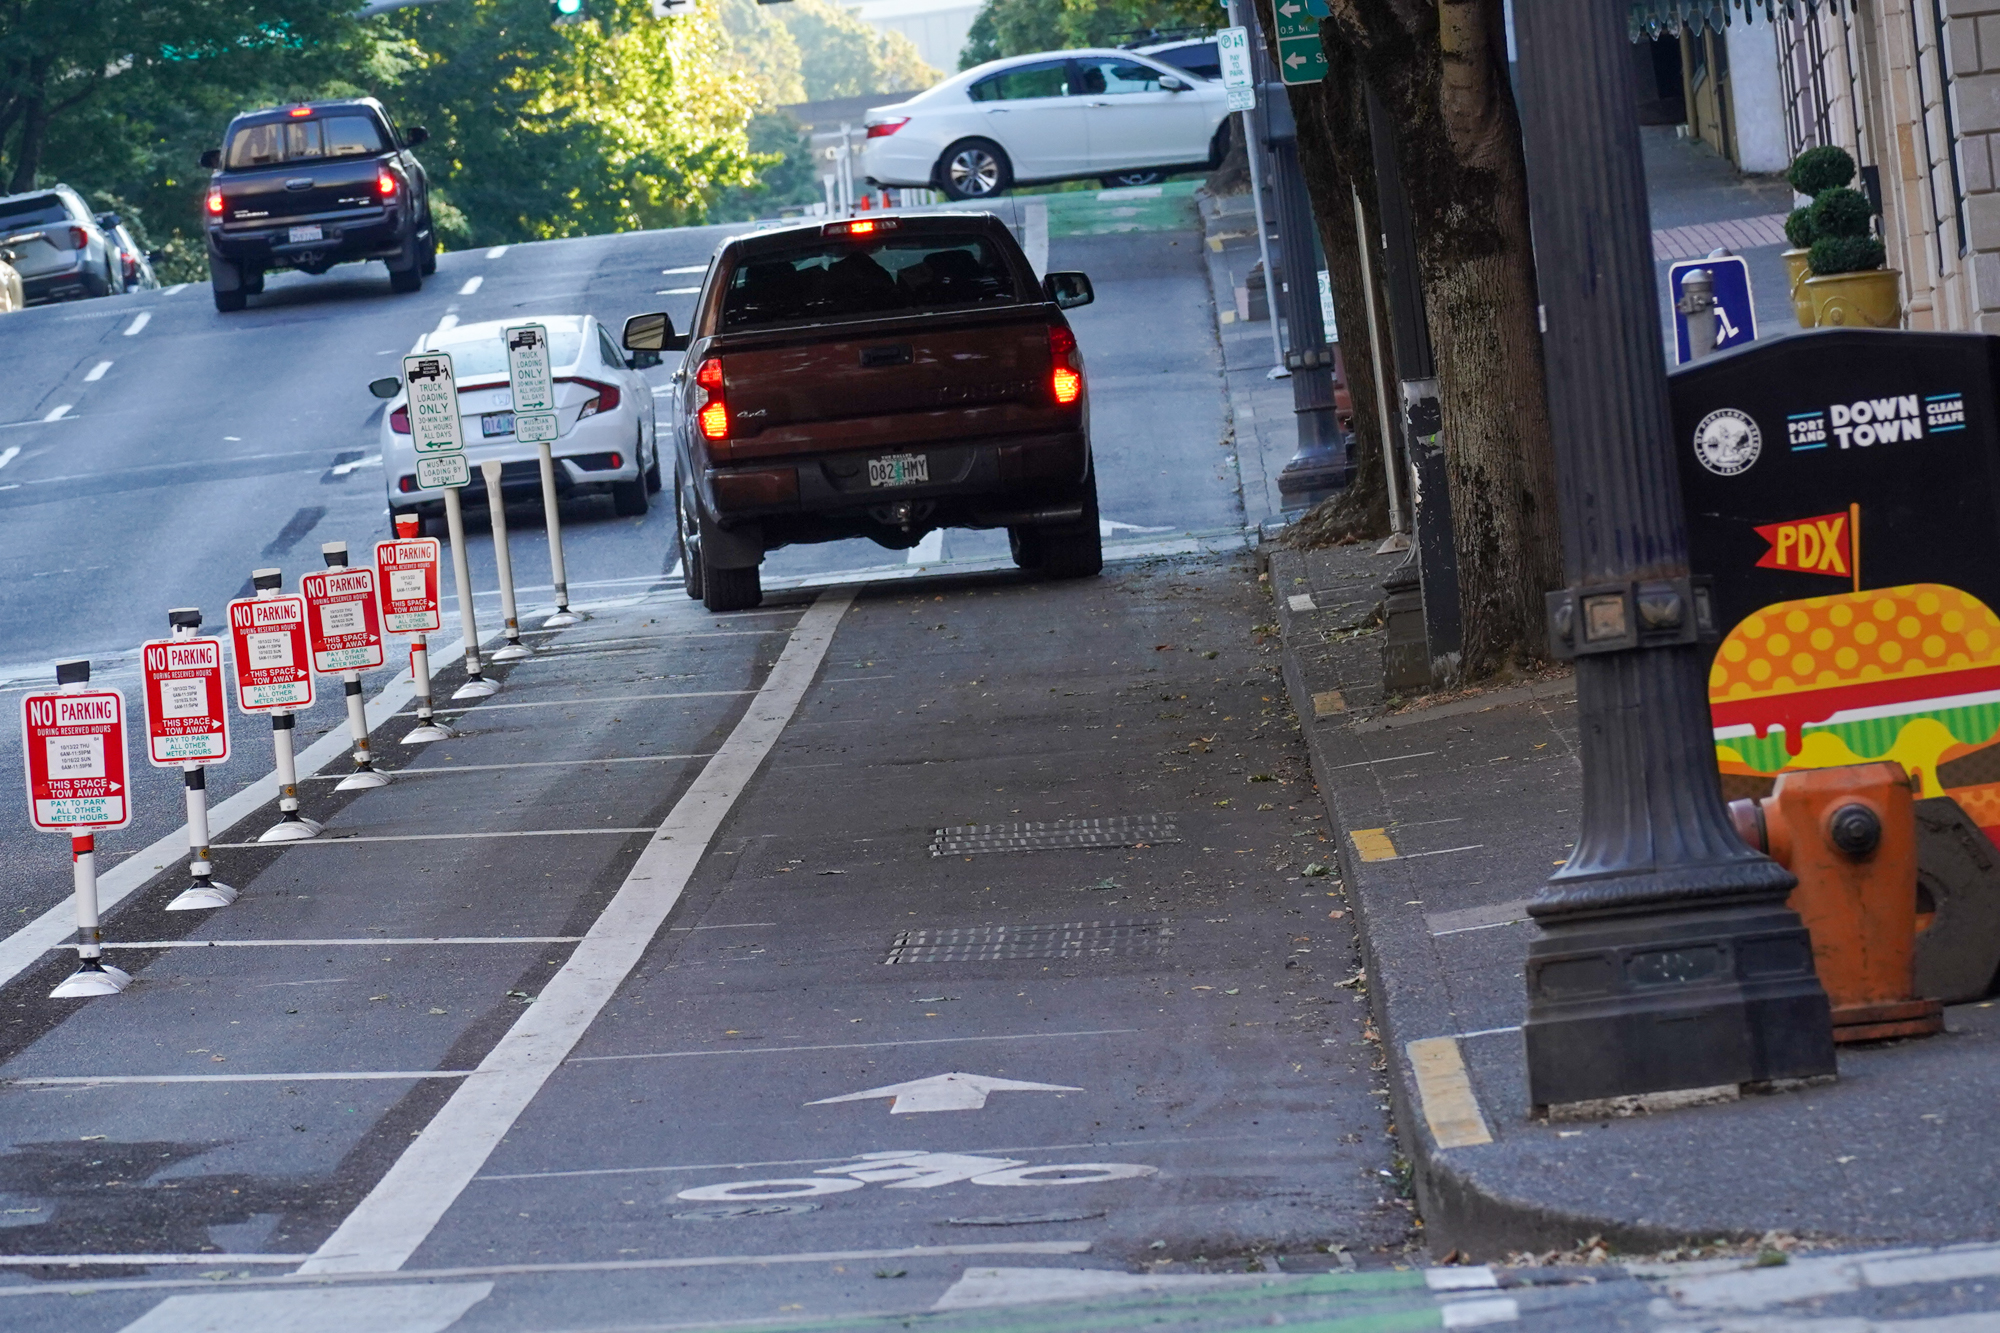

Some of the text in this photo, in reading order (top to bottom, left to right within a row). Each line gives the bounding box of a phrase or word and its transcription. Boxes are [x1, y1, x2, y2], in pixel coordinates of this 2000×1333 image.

[1280, 26, 1294, 34] 0.5
[517, 360, 542, 368] LOADING
[518, 369, 542, 379] ONLY
[419, 383, 442, 392] TRUCK
[417, 393, 448, 402] LOADING
[419, 403, 448, 415] ONLY
[1830, 395, 1920, 427] DOWN
[1926, 401, 1963, 414] CLEAN
[418, 416, 438, 424] 30-MIN
[1927, 411, 1965, 426] &SAFE
[1788, 419, 1825, 433] PORT
[1789, 430, 1826, 444] LAND
[1833, 417, 1923, 450] TOWN
[427, 459, 457, 468] MUSICIAN
[424, 467, 451, 476] LOADING
[871, 460, 925, 480] 082 HMY
[433, 475, 455, 483] PERMIT
[1777, 517, 1846, 574] PDX
[380, 546, 431, 564] NO PARKING
[307, 576, 368, 598] NO PARKING
[234, 604, 296, 627] NO PARKING
[257, 625, 280, 633] RESERVED
[343, 633, 368, 641] SPACE
[346, 640, 367, 648] AWAY
[147, 647, 212, 671] NO PARKING
[153, 672, 170, 680] DURING
[171, 670, 195, 678] RESERVED
[270, 667, 296, 676] SPACE
[30, 700, 112, 726] NO PARKING
[162, 717, 210, 727] THIS SPACE
[37, 725, 111, 736] DURING RESERVED HOURS
[165, 727, 183, 735] TOW
[47, 779, 108, 789] THIS SPACE
[50, 788, 105, 798] TOW AWAY
[83, 798, 106, 806] PARK
[75, 806, 102, 814] OTHER
